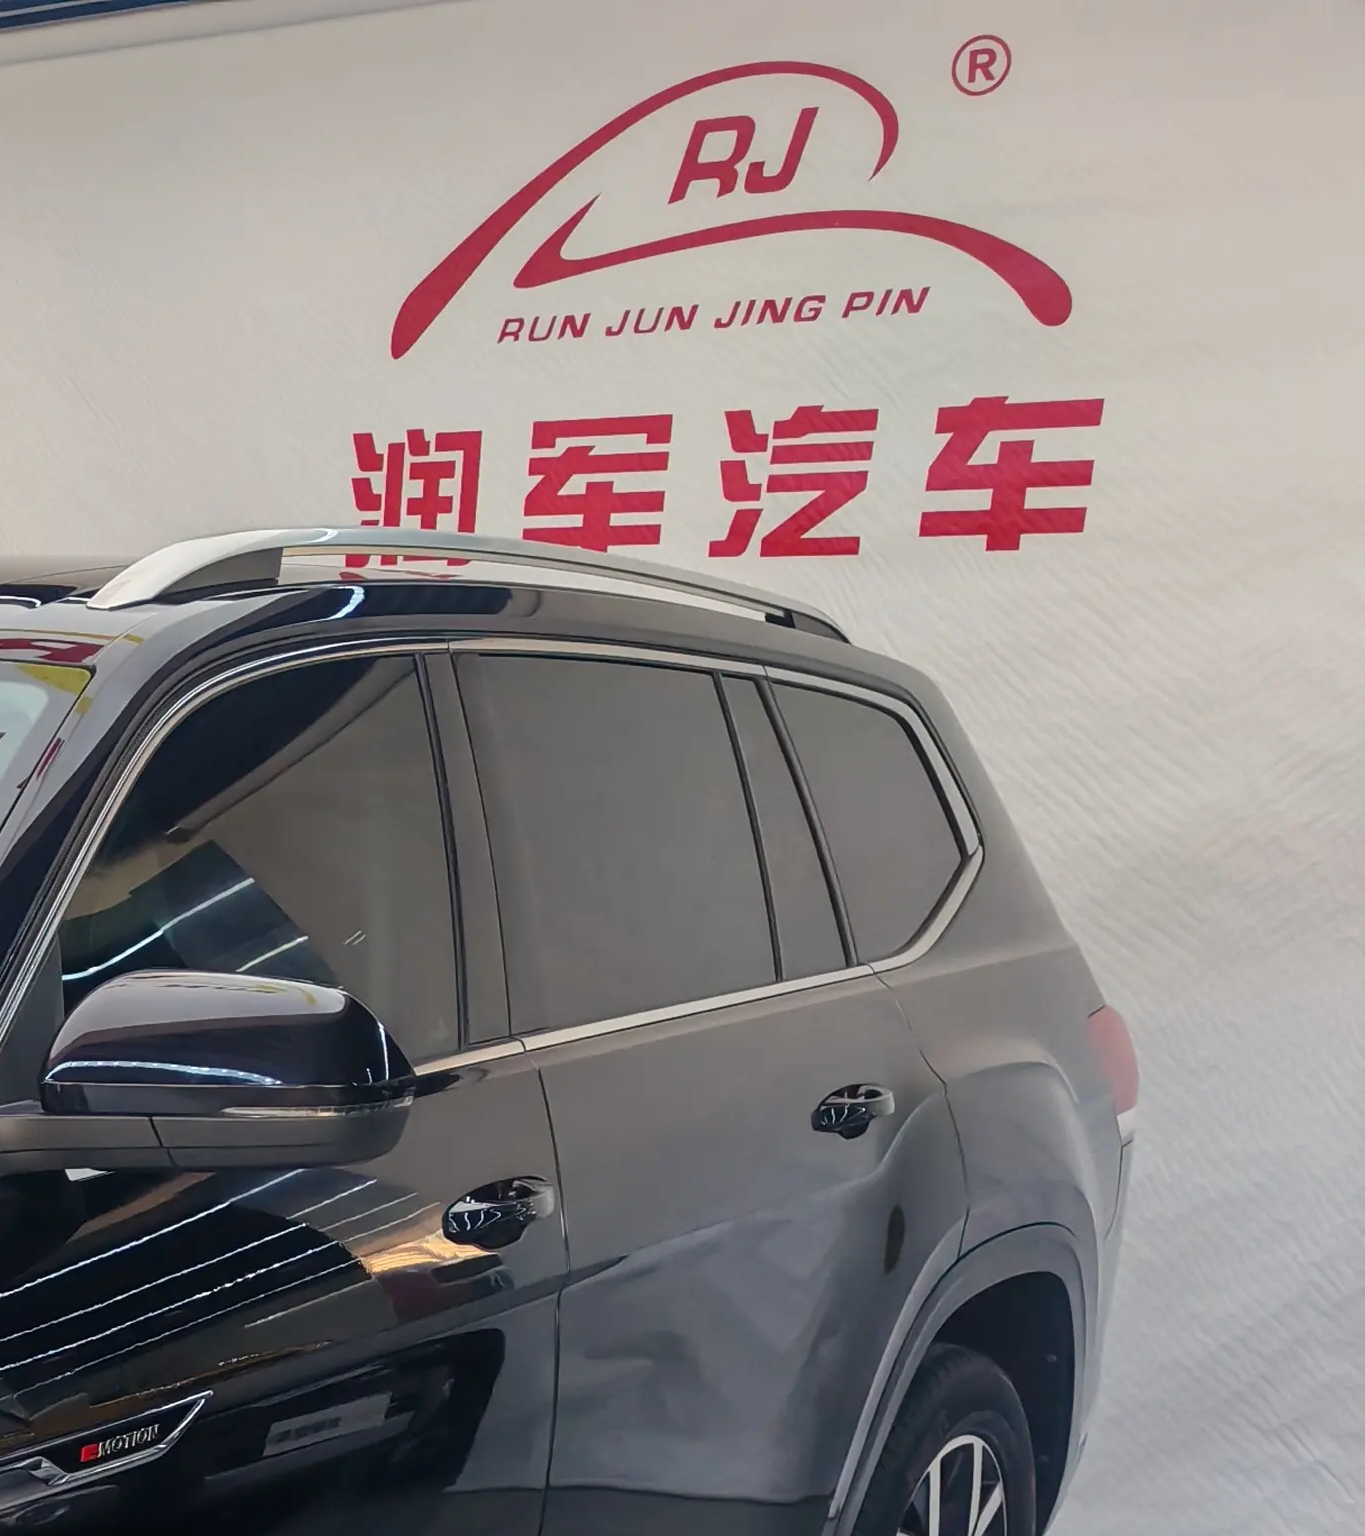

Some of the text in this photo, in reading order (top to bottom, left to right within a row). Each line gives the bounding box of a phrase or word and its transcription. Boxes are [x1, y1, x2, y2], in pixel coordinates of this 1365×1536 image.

[668, 107, 818, 205] RJ
[498, 287, 931, 344] RUN JUN JING PIN
[343, 396, 1105, 570] 润军汽车
